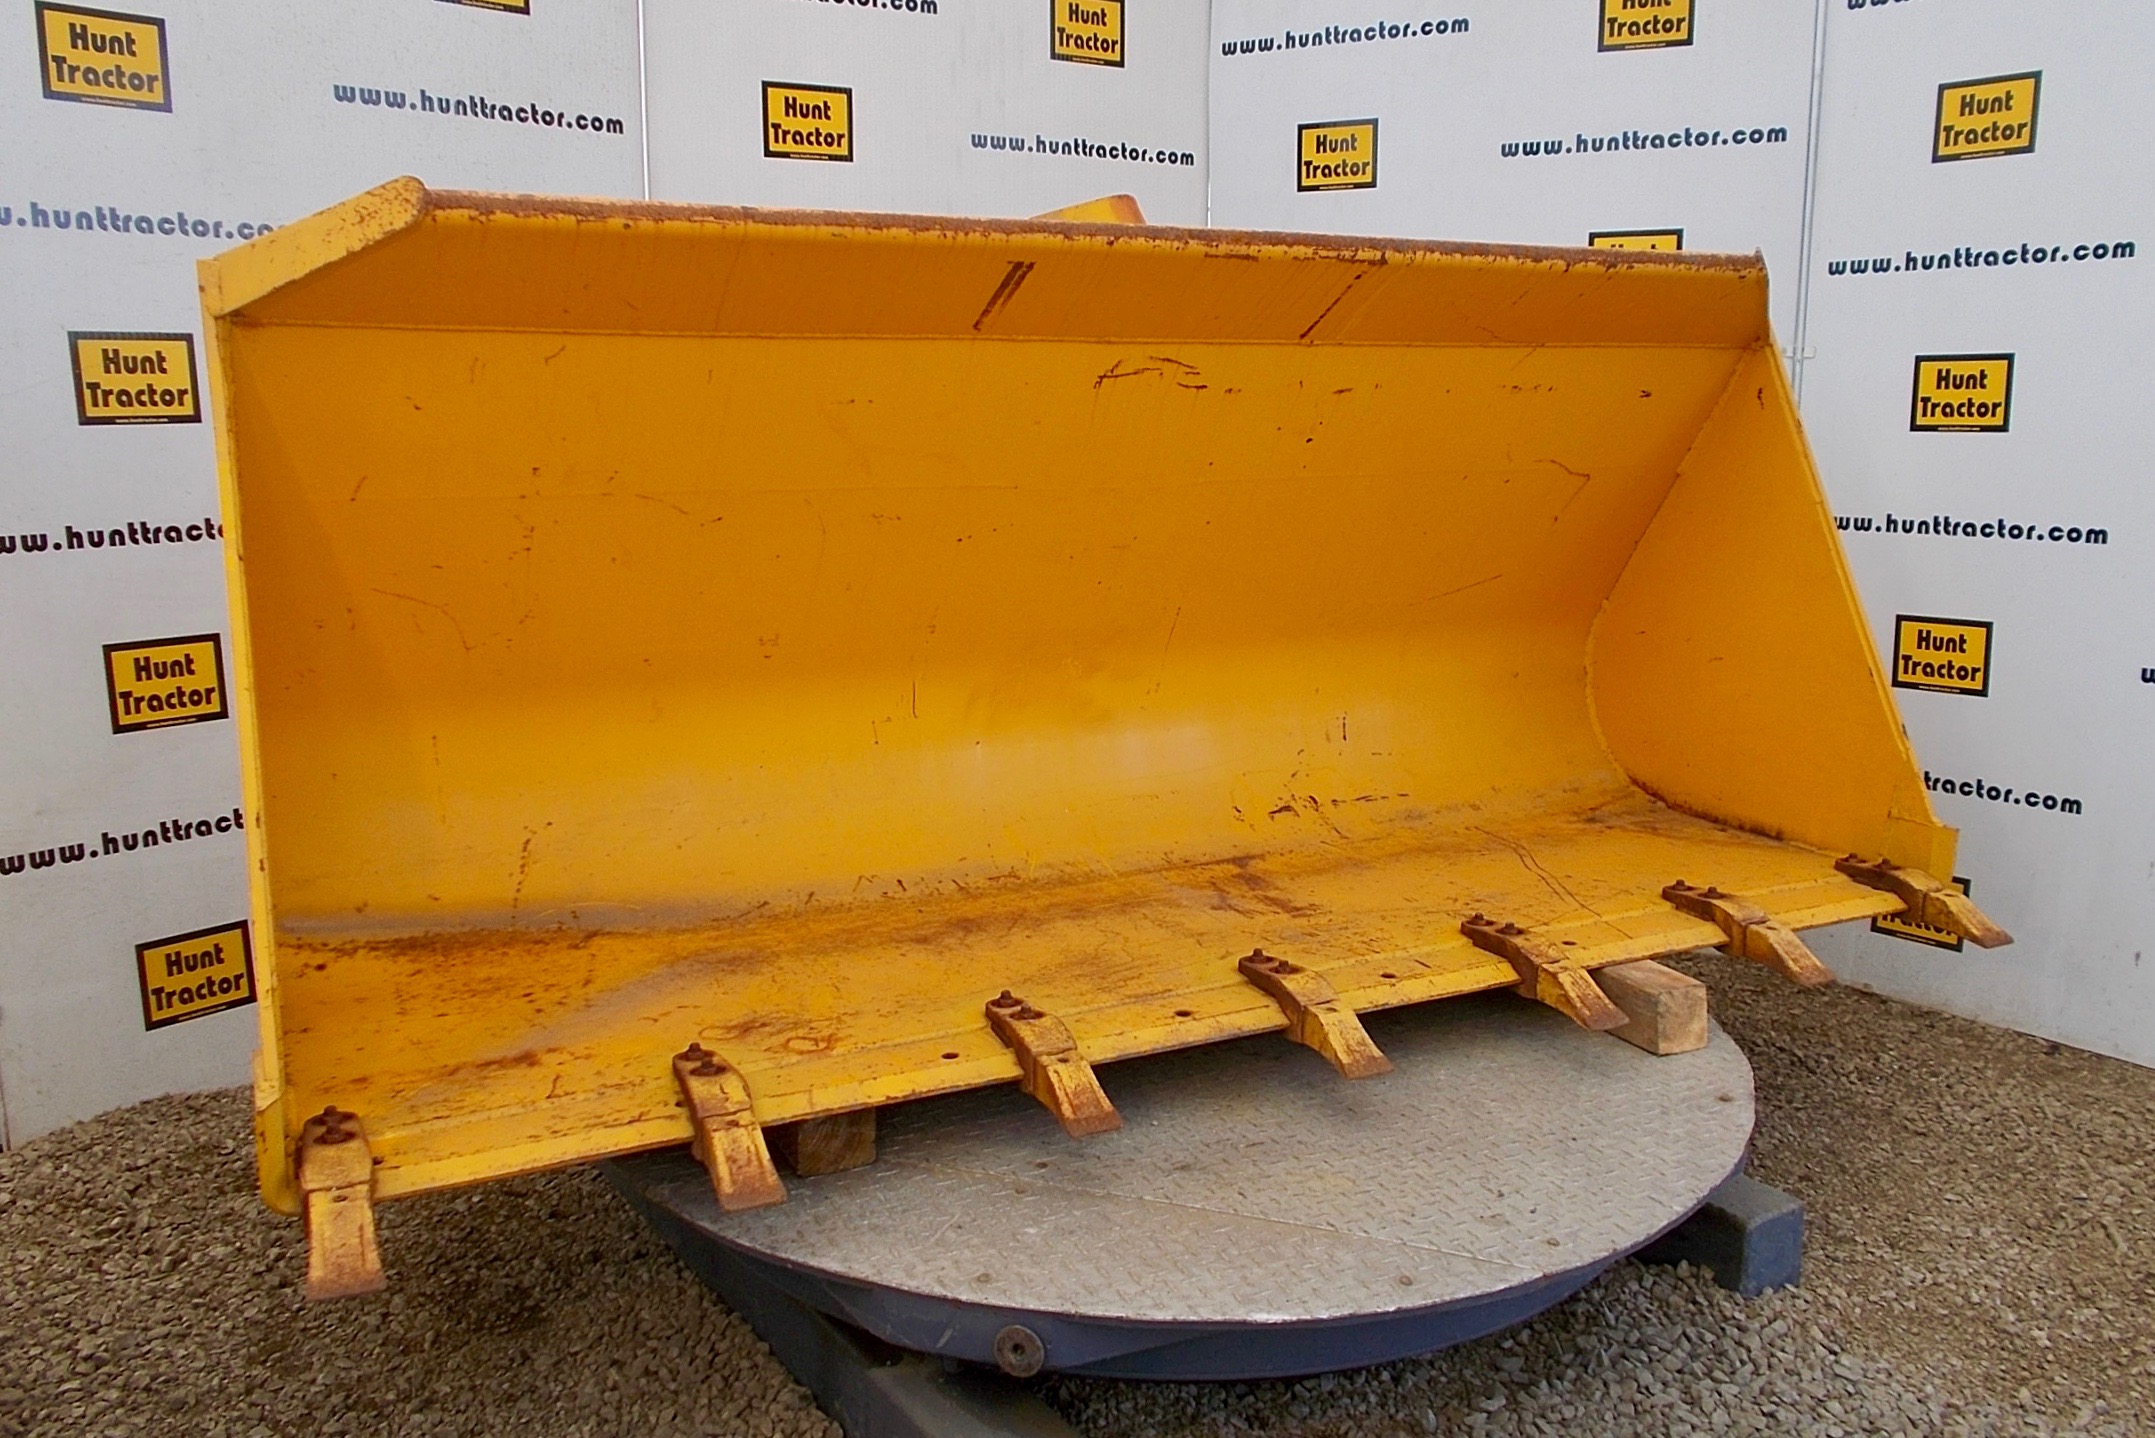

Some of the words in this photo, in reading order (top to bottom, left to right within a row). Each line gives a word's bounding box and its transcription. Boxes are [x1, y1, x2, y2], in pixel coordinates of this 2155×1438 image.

[1068, 2, 1107, 27] Hunt
[1607, 14, 1687, 38] Tractor
[68, 22, 138, 58] Hunt
[1056, 26, 1119, 54] Tractor
[1221, 18, 1469, 57] www.hunttractor.com
[50, 54, 160, 95] Tractor
[333, 84, 624, 135] www.hunttractor.com
[784, 95, 831, 121] Hunt
[1958, 89, 2014, 118] Hunt
[769, 121, 847, 149] Tractor
[1315, 133, 1358, 155] Hunt
[1501, 127, 1788, 158] www.hunttractor.com
[1942, 119, 2030, 148] Tractor
[971, 134, 1195, 166] www.hunttractor.com
[1302, 156, 1371, 180] Tractor
[1828, 241, 2136, 276] www.hunttractor.com
[101, 348, 168, 375] Hunt
[1936, 368, 1988, 390] Hunt
[85, 381, 190, 408] Tractor
[1919, 396, 2003, 418] Tractor
[1916, 628, 1967, 654] Hunt
[133, 653, 196, 682] Hunt
[1901, 653, 1982, 683] Tractor
[118, 684, 216, 717] Tractor
[164, 943, 225, 978] Hunt
[150, 971, 245, 1012] Tractor
